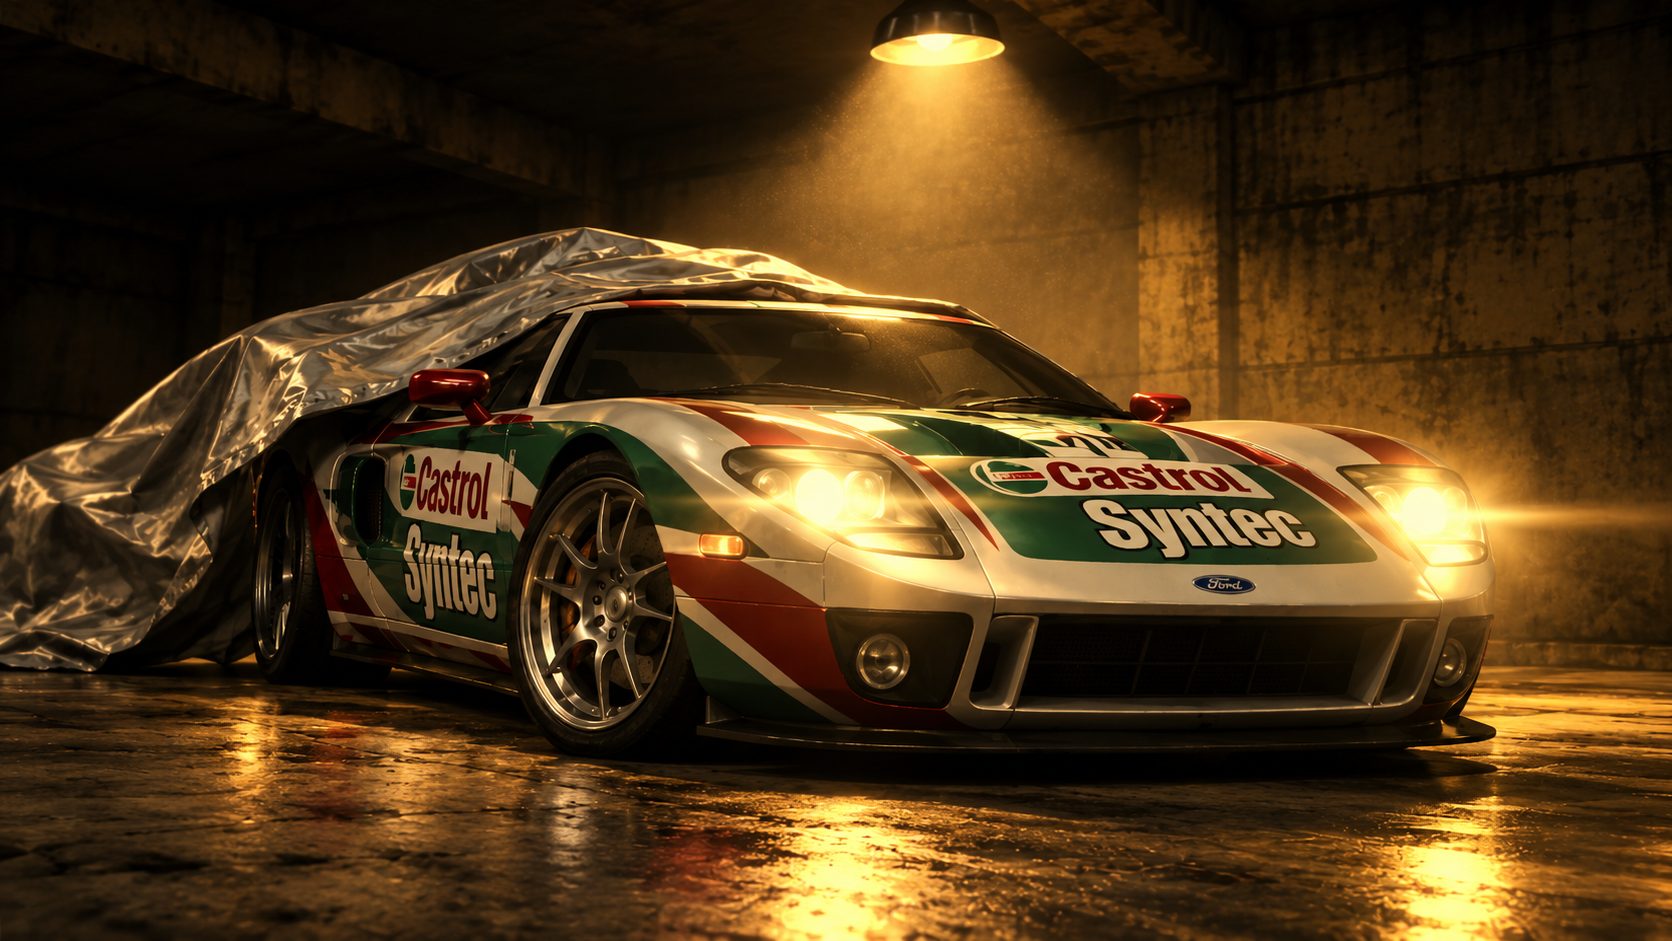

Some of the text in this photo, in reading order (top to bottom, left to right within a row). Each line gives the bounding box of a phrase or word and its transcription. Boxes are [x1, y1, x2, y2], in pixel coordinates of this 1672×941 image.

[416, 455, 492, 520] Castrol
[1046, 460, 1252, 494] Castrol
[1082, 499, 1318, 560] Syntec
[403, 522, 498, 621] Syntec
[1207, 577, 1243, 590] Ford
